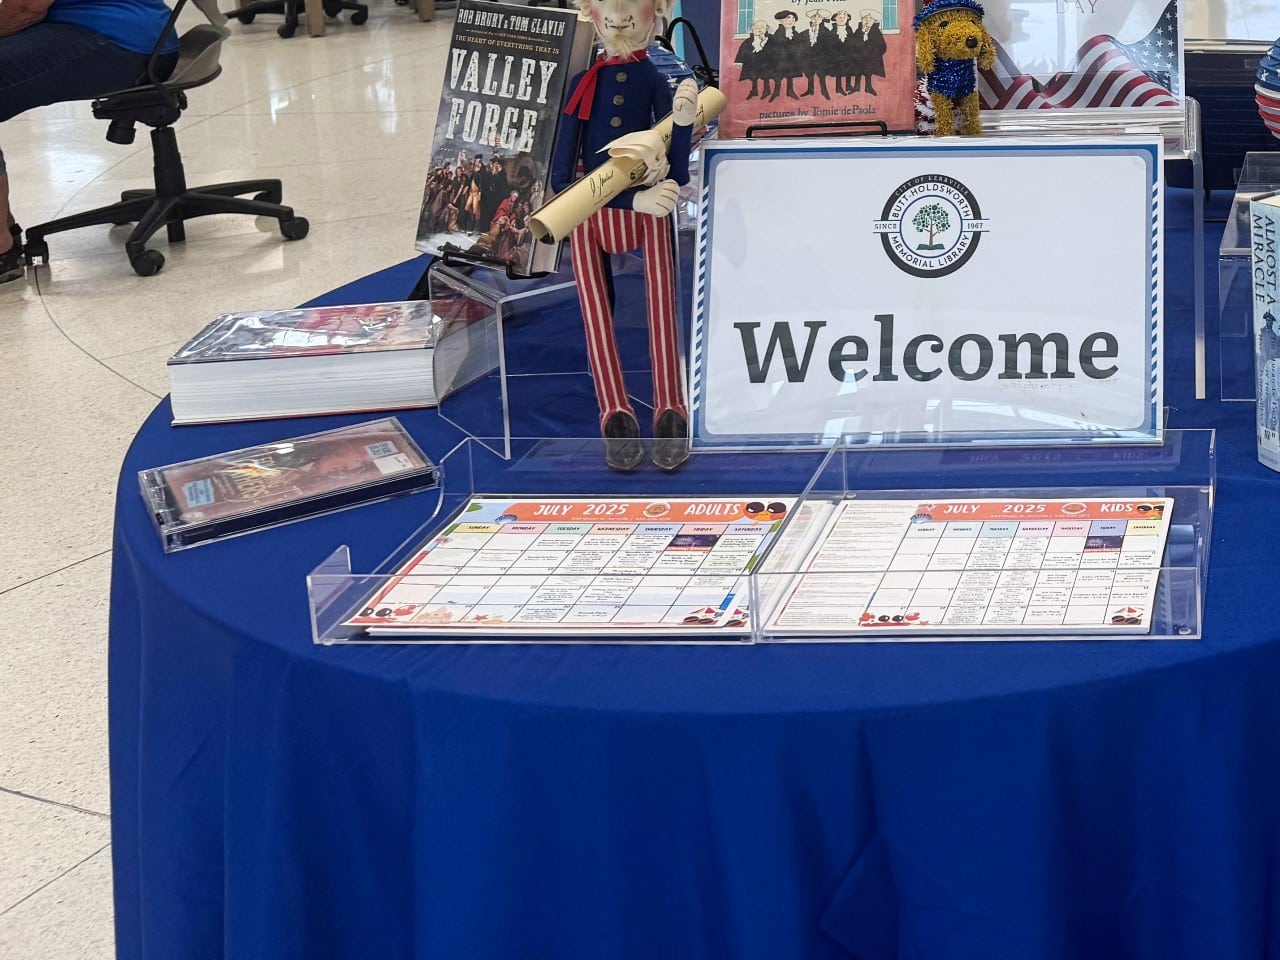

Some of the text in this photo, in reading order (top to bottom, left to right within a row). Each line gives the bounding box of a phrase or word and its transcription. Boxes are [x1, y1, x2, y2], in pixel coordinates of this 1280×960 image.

[457, 8, 475, 25] BOB
[474, 10, 505, 29] DRURY
[509, 15, 530, 32] TOM
[530, 18, 566, 37] CLAVIN
[467, 35, 488, 45] HEART
[496, 40, 533, 51] EVERYTHING
[535, 45, 551, 53] THAT
[450, 47, 558, 105] VALLEY
[445, 97, 538, 153] FORGE
[759, 108, 795, 122] pictures
[811, 105, 839, 117] Tomie
[892, 183, 971, 219] BUTT-HOLDSWORTH
[967, 222, 984, 230] 1967
[891, 234, 970, 268] MEMORIAL LIBRARY
[1252, 214, 1265, 303] MIRACLE
[1264, 214, 1277, 305] ALMOST A
[733, 313, 1119, 384] Welcome
[533, 503, 742, 516] JULY 2025 ADULTS
[943, 504, 981, 514] JULY
[1002, 504, 1047, 513] 2025
